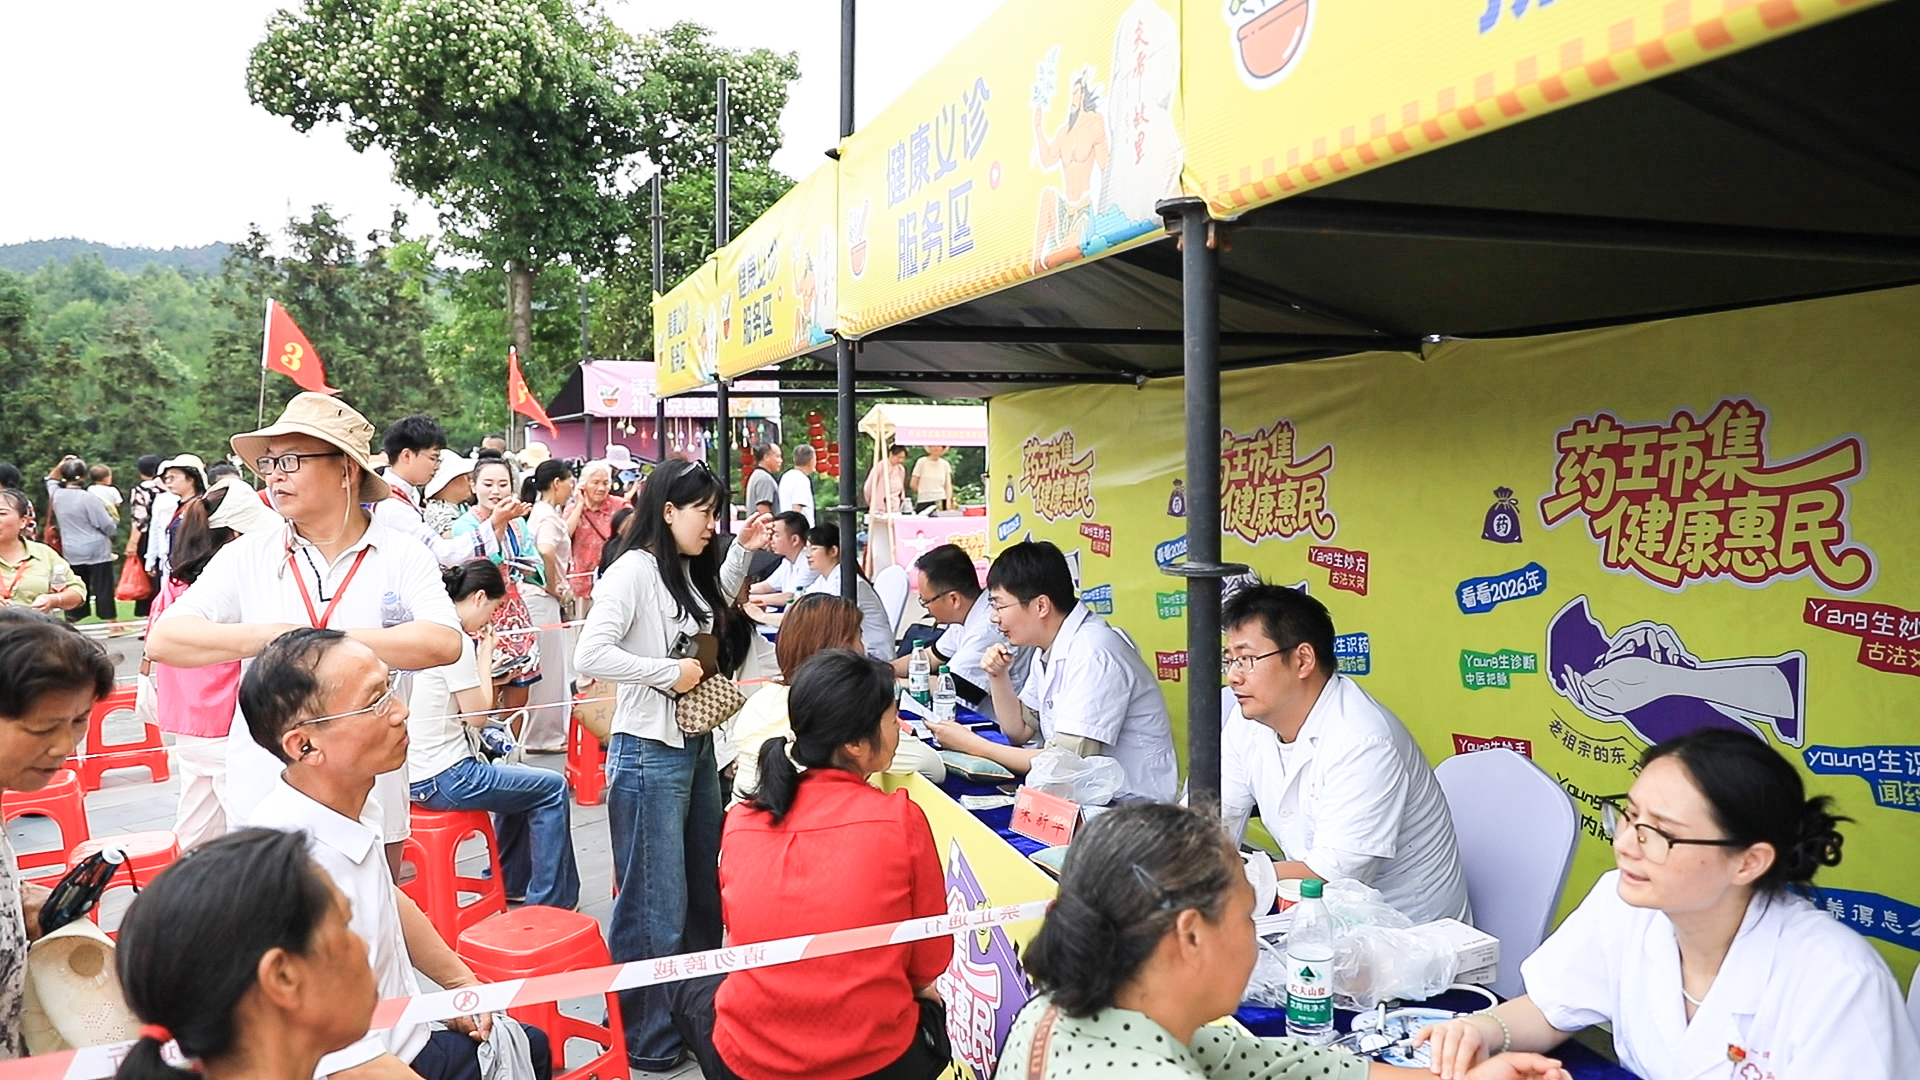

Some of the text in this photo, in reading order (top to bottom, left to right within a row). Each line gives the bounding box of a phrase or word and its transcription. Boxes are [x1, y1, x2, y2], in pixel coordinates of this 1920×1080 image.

[888, 77, 989, 209] 健康义诊
[897, 181, 974, 281] 服务区
[280, 342, 303, 371] 3
[1545, 405, 1855, 520] 药王市集
[1222, 478, 1335, 541] 健康惠民
[1493, 514, 1511, 534] 药
[1594, 489, 1865, 584] 健康惠民
[1311, 548, 1366, 573] Yang生妙方
[1461, 571, 1542, 608] 看看2026年
[1334, 637, 1368, 653] 生识药
[1464, 654, 1535, 670] Young生诊断
[1465, 672, 1508, 686] 中医把脉
